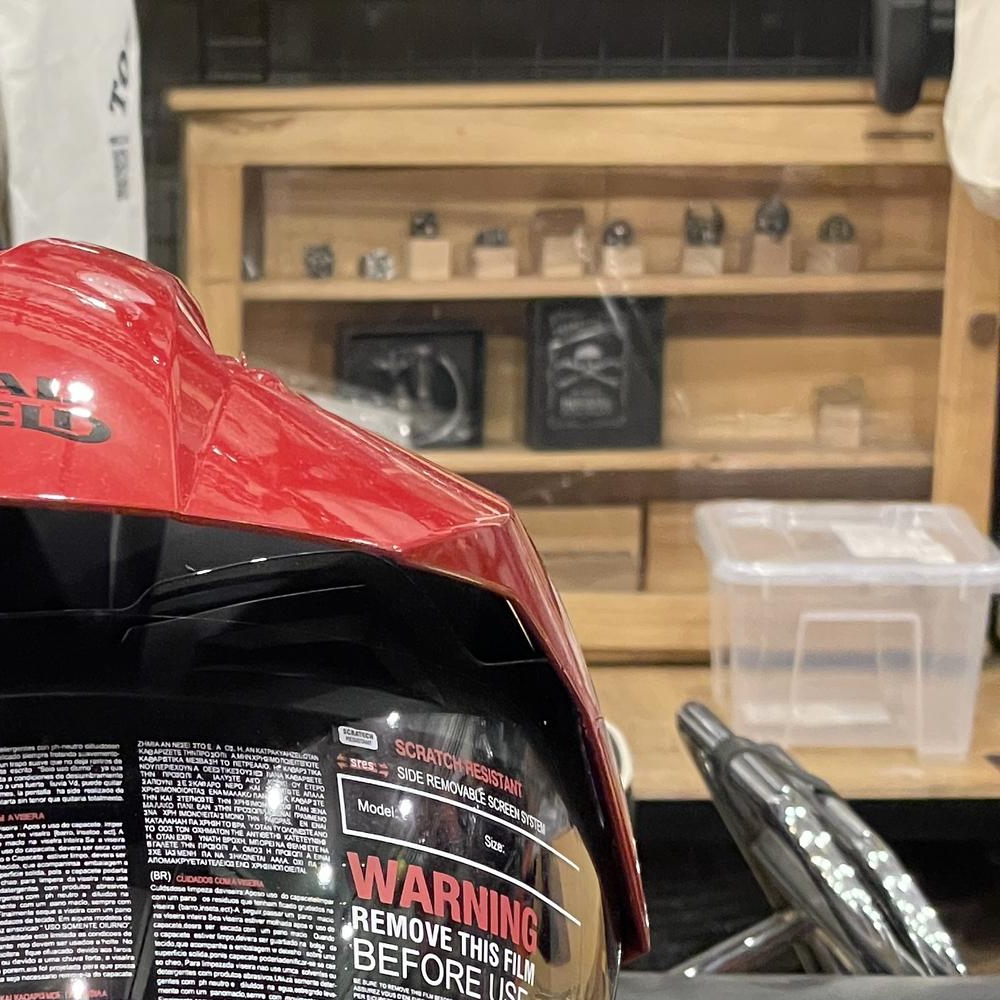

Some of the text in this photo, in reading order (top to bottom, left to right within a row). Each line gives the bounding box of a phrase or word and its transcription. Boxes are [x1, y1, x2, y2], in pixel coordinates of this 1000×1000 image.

[394, 738, 524, 798] SCRATCH RESISTANT
[357, 799, 399, 818] Model:
[397, 766, 546, 836] SIDE REMOVABLE SCREEN SYSTEM
[484, 834, 506, 854] Size:
[150, 870, 172, 883] (BR)
[346, 851, 538, 954] WARNING
[352, 905, 535, 987] REMOVE THIS FILM
[353, 938, 483, 1000] BEFORE
